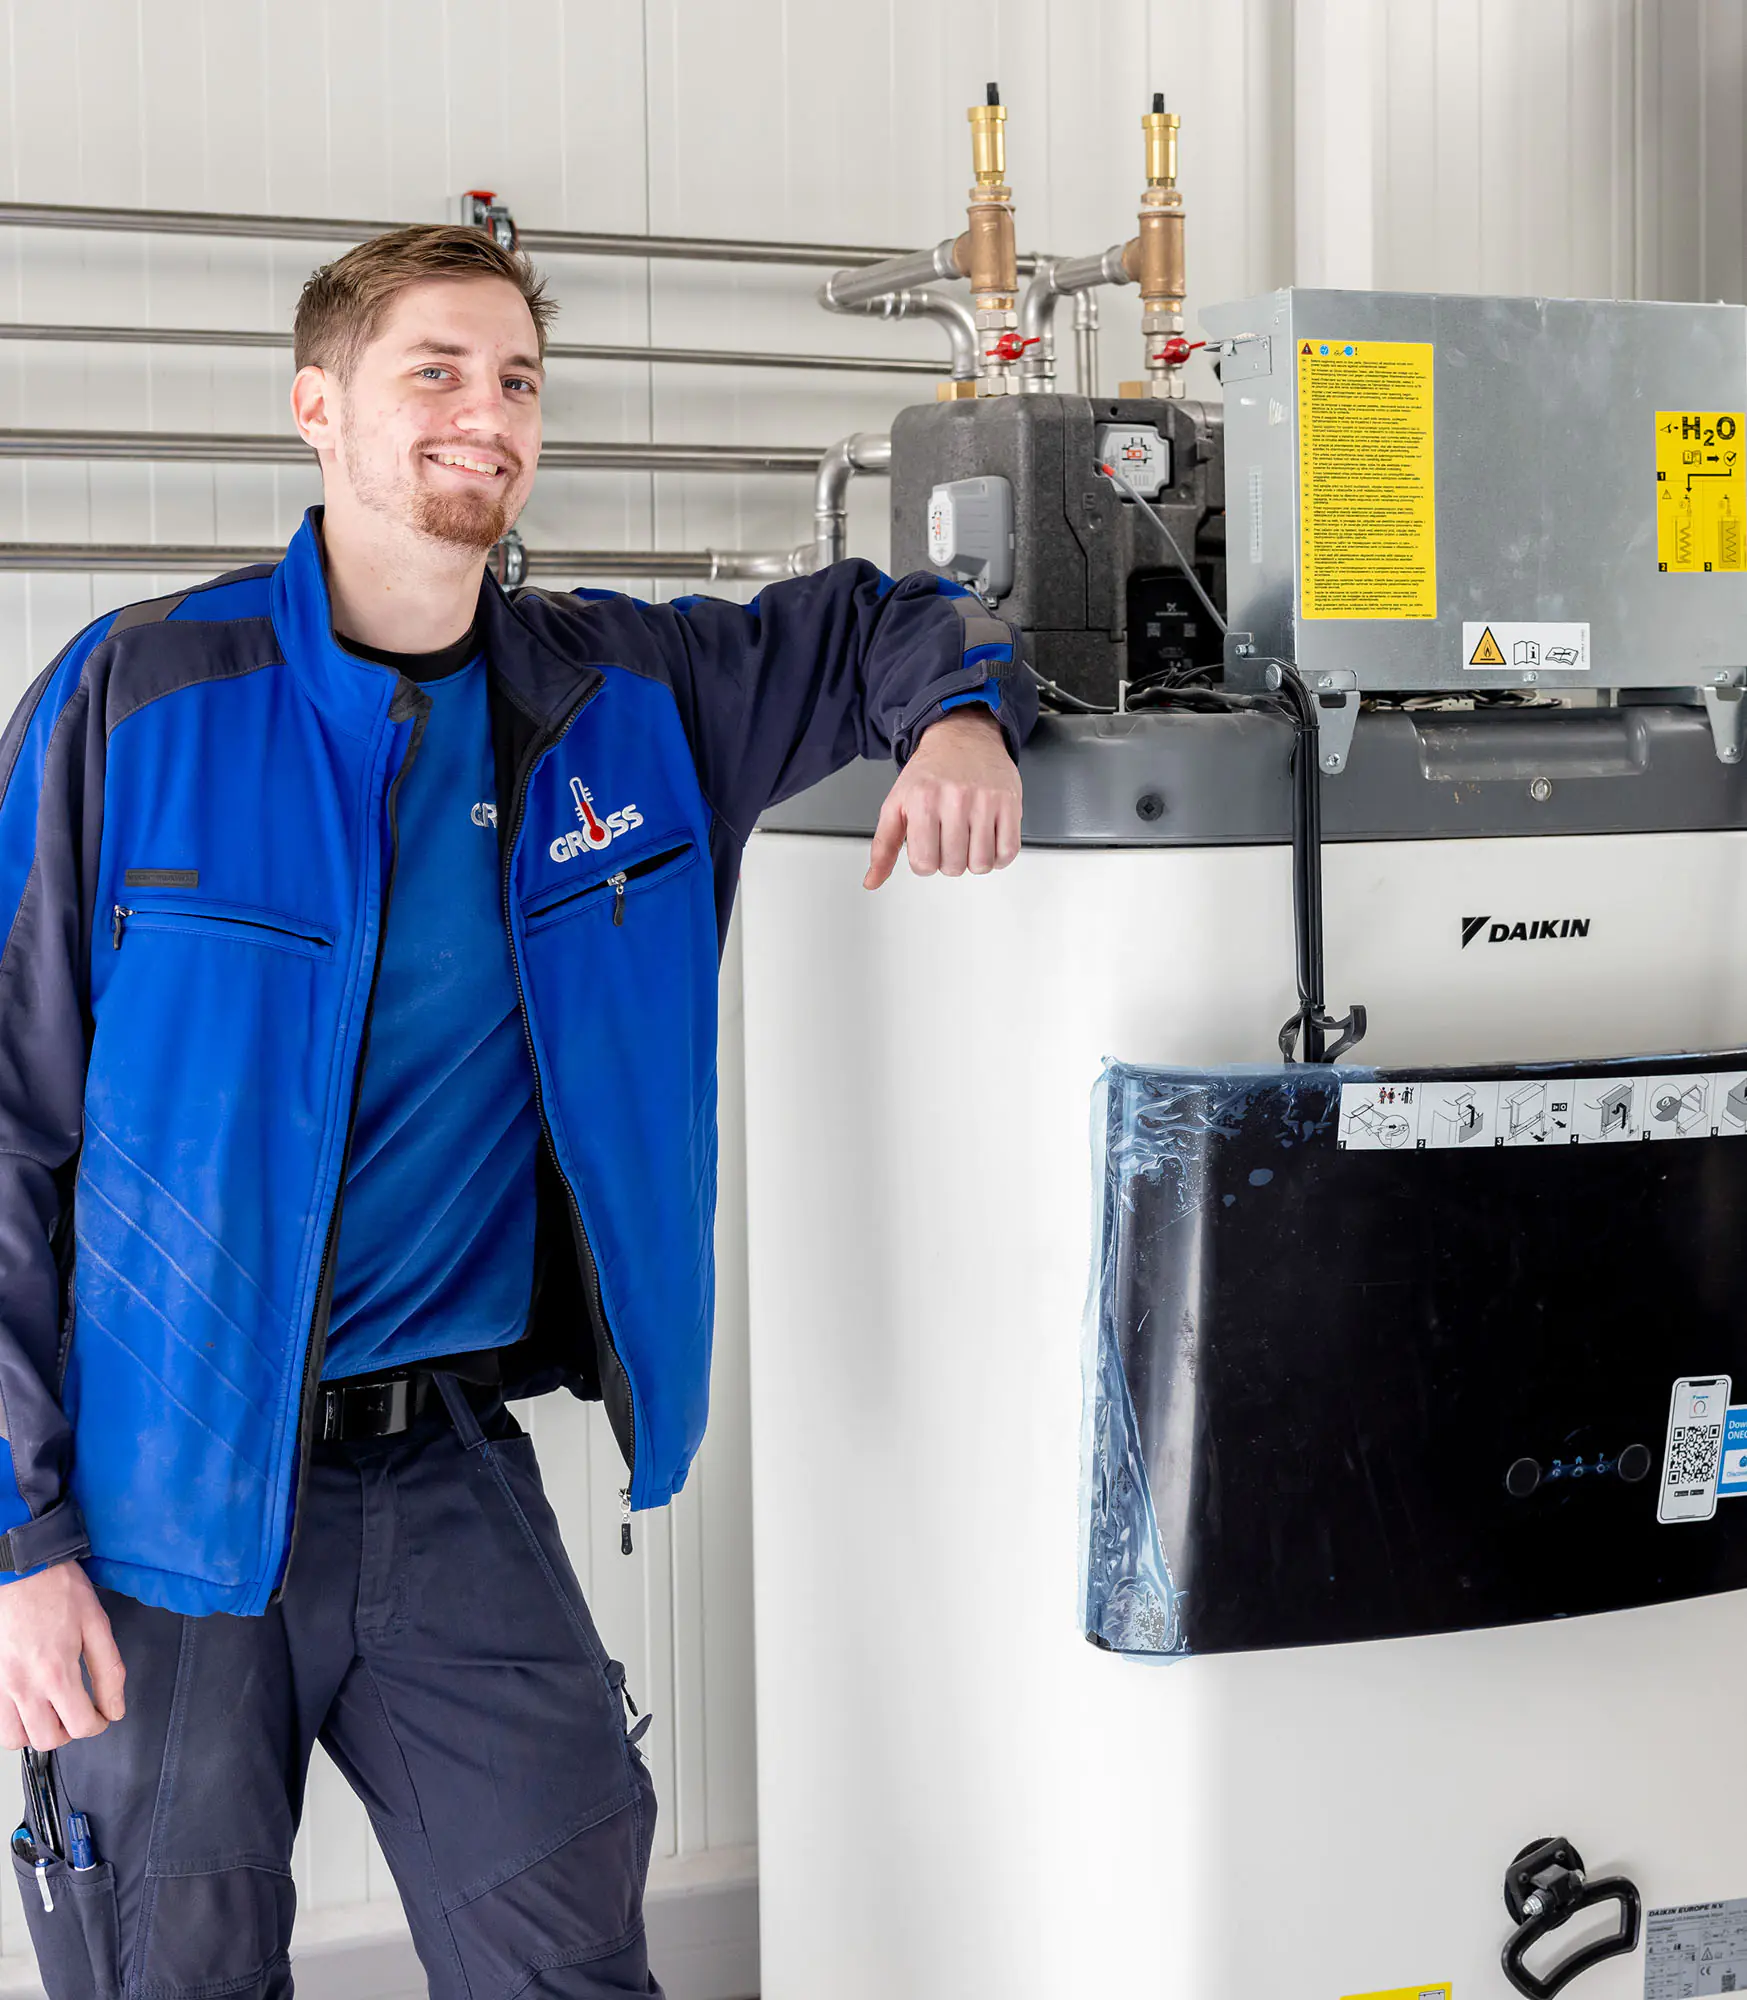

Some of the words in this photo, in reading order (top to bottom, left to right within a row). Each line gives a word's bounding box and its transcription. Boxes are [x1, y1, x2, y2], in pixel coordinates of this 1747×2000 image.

[549, 800, 644, 863] GROSS
[1488, 918, 1591, 943] DAIKIN
[1648, 1908, 1676, 1917] DAIKIN
[1678, 1904, 1710, 1913] EUROPE
